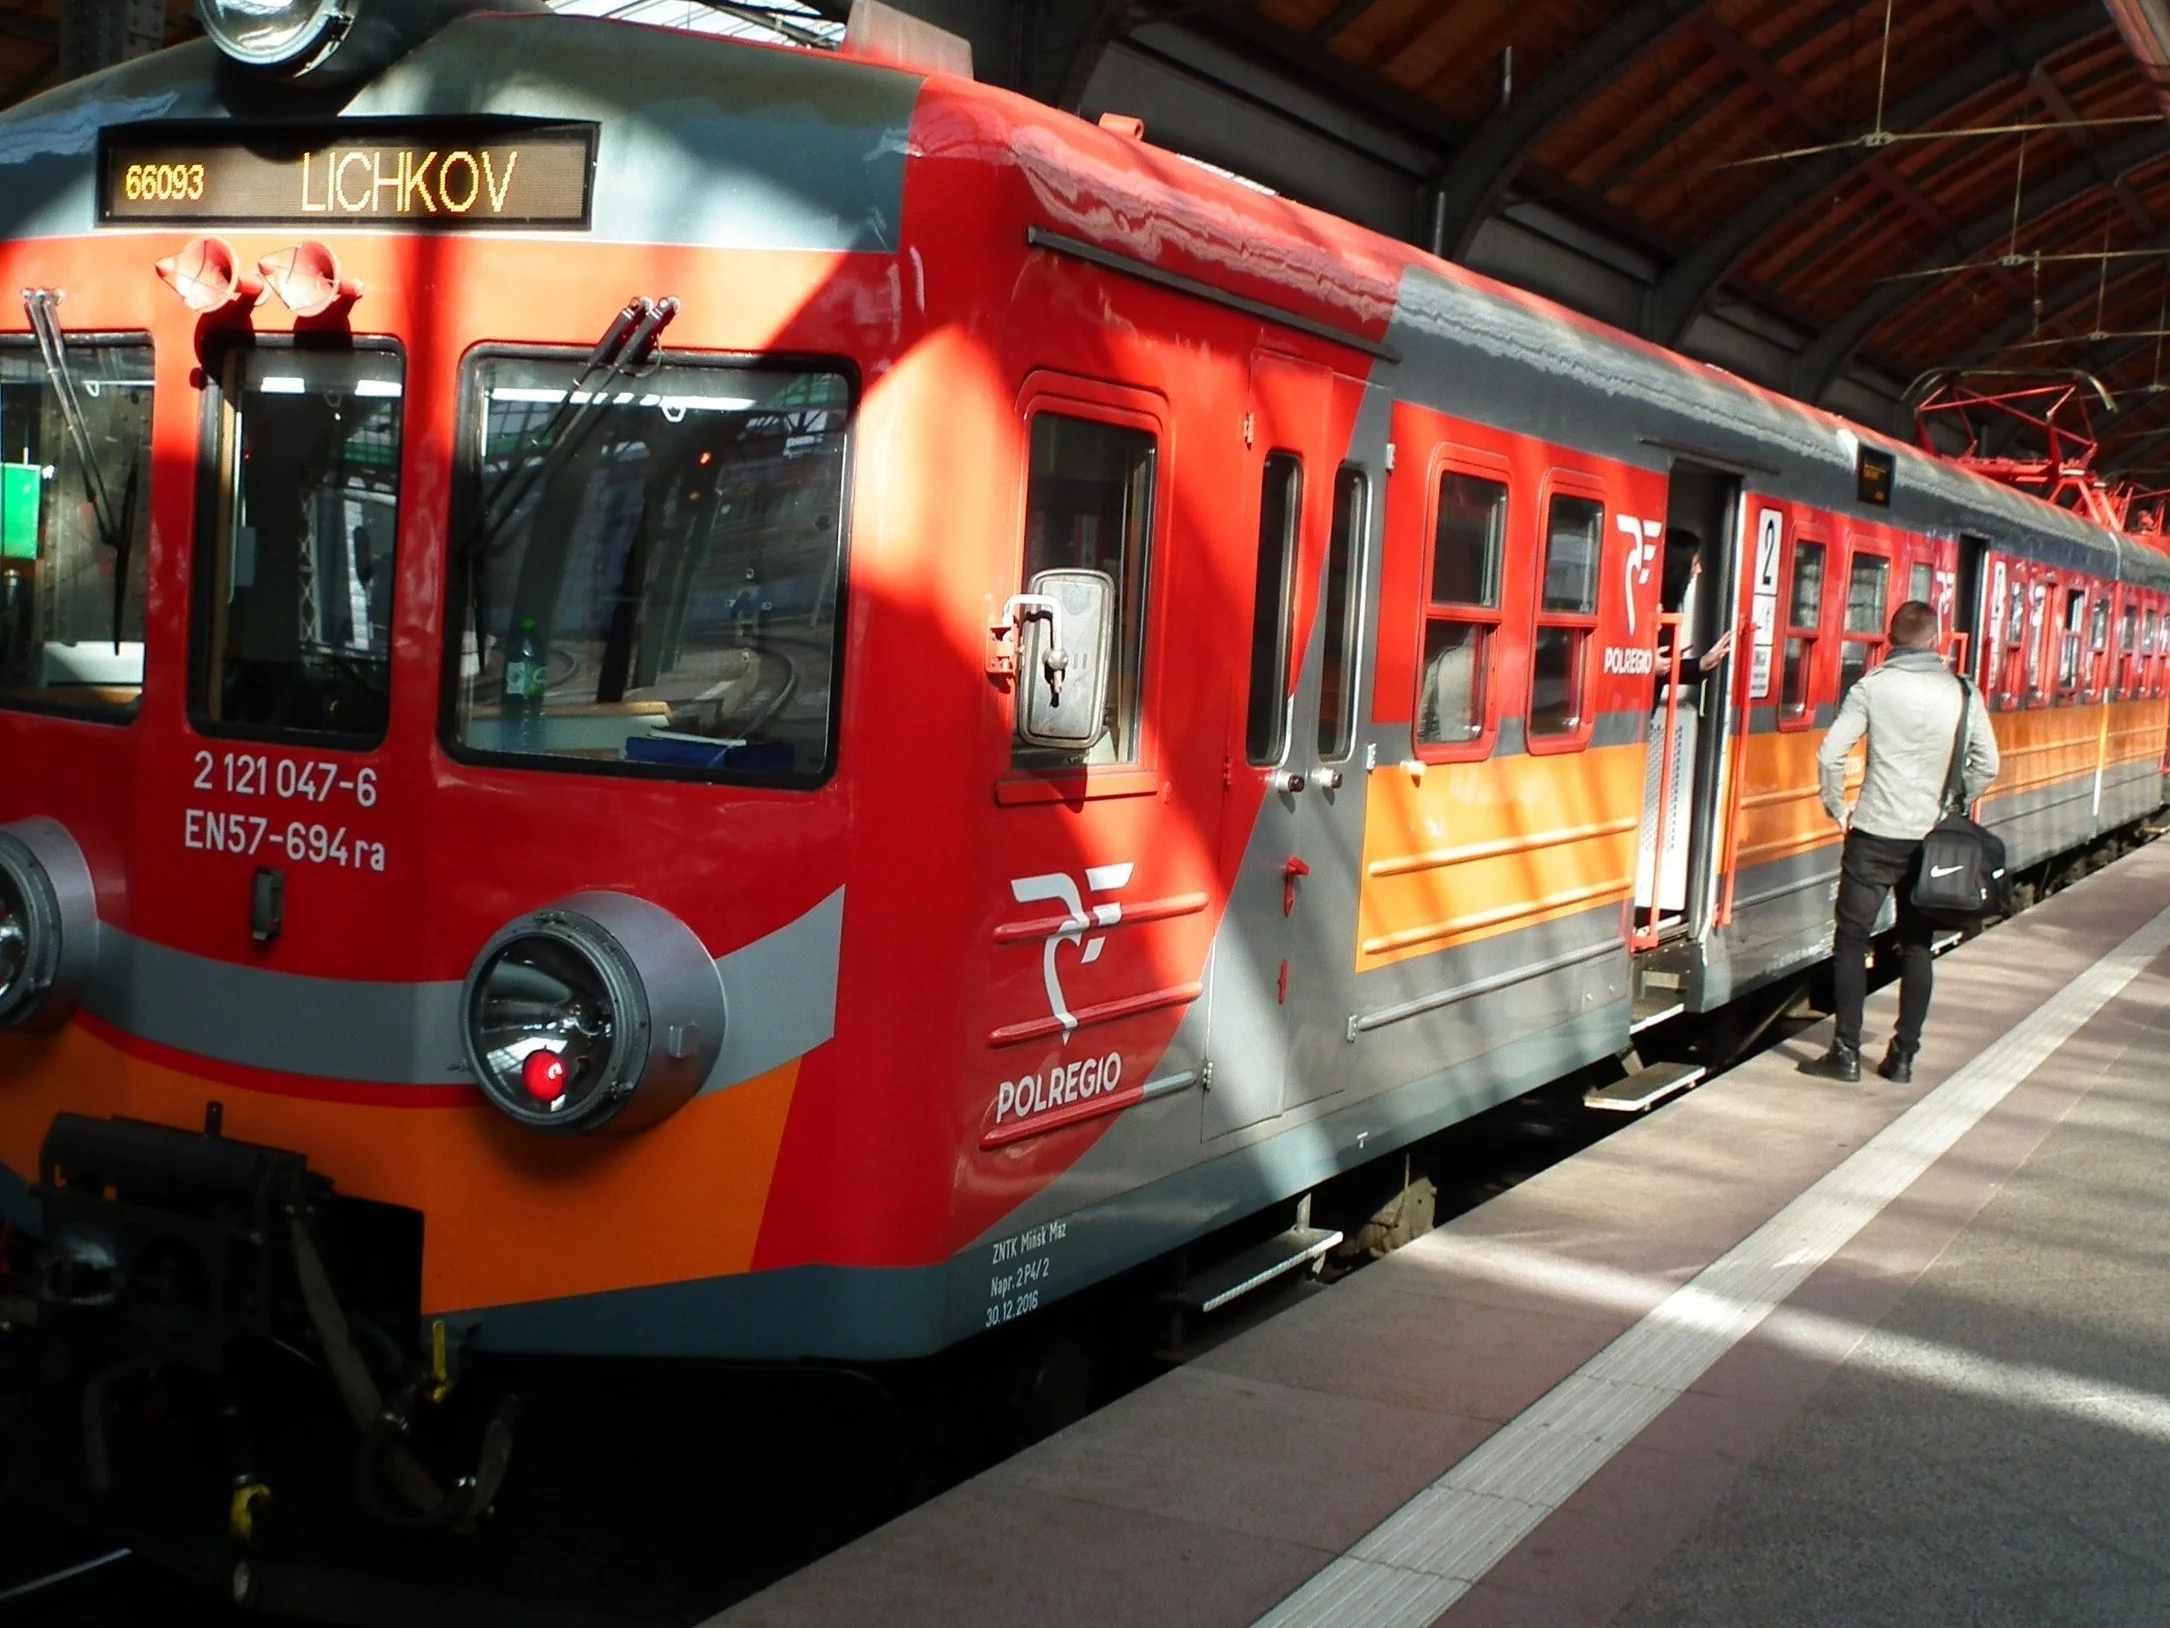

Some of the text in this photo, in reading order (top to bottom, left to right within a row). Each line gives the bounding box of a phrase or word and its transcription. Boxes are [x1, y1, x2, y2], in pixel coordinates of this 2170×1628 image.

[126, 151, 517, 212] 66093 LICHKOV
[1762, 519, 1775, 585] 2
[194, 750, 377, 807] 2 121 047-6
[996, 1052, 1121, 1124] POLREGIO
[992, 1236, 1018, 1265] ZNTK
[1049, 1221, 1067, 1242] Maz
[985, 1290, 1039, 1328] 30.12.2016
